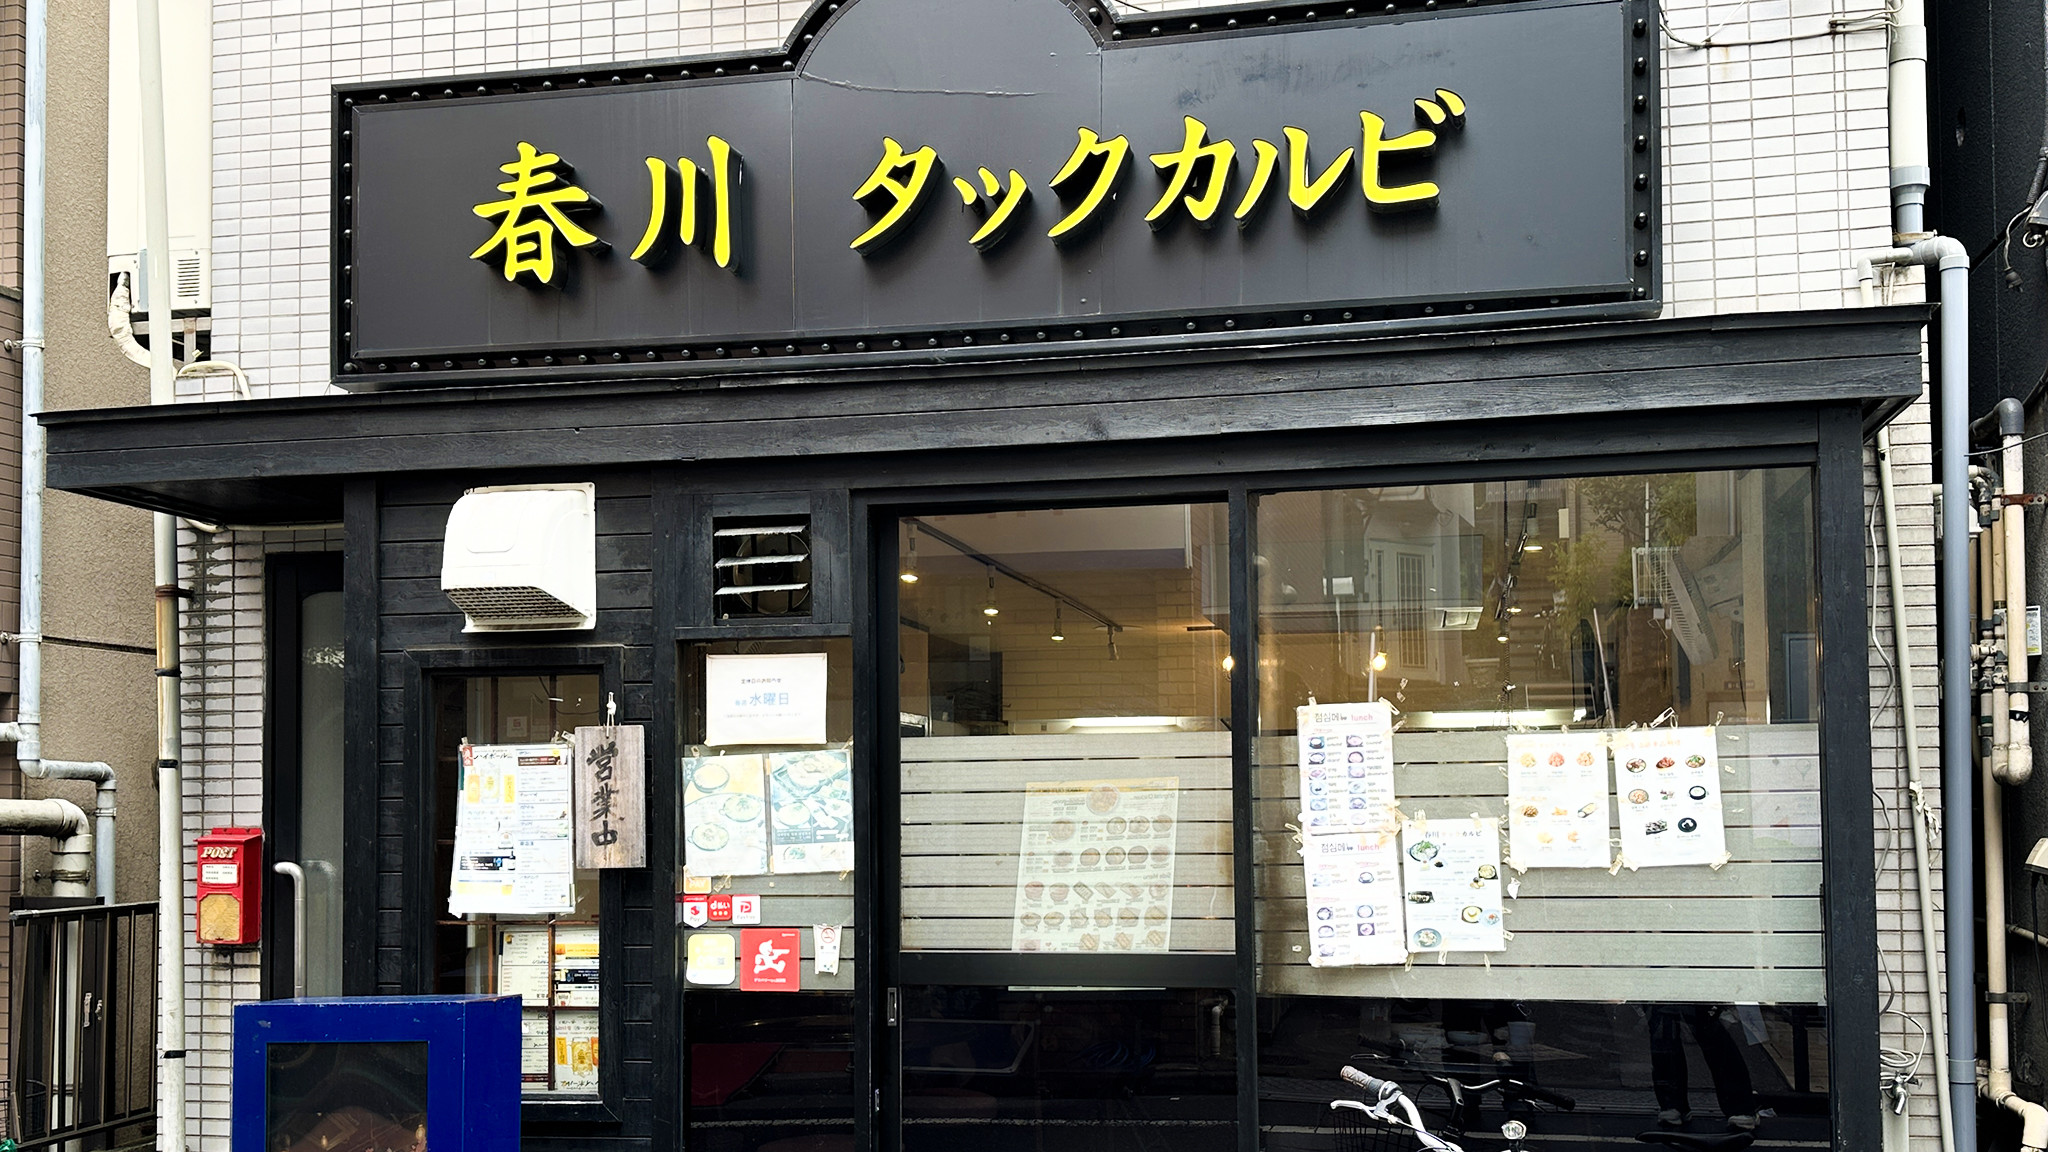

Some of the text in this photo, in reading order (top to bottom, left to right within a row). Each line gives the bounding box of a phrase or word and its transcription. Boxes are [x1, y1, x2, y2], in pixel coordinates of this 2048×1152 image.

[470, 88, 1466, 283] 春川 タックカルビ
[749, 692, 789, 706] 水曜日
[1351, 714, 1373, 722] lunch
[586, 740, 619, 850] 営業中
[200, 846, 237, 859] POST
[1357, 844, 1380, 852] lunch
[710, 900, 731, 910] d払い
